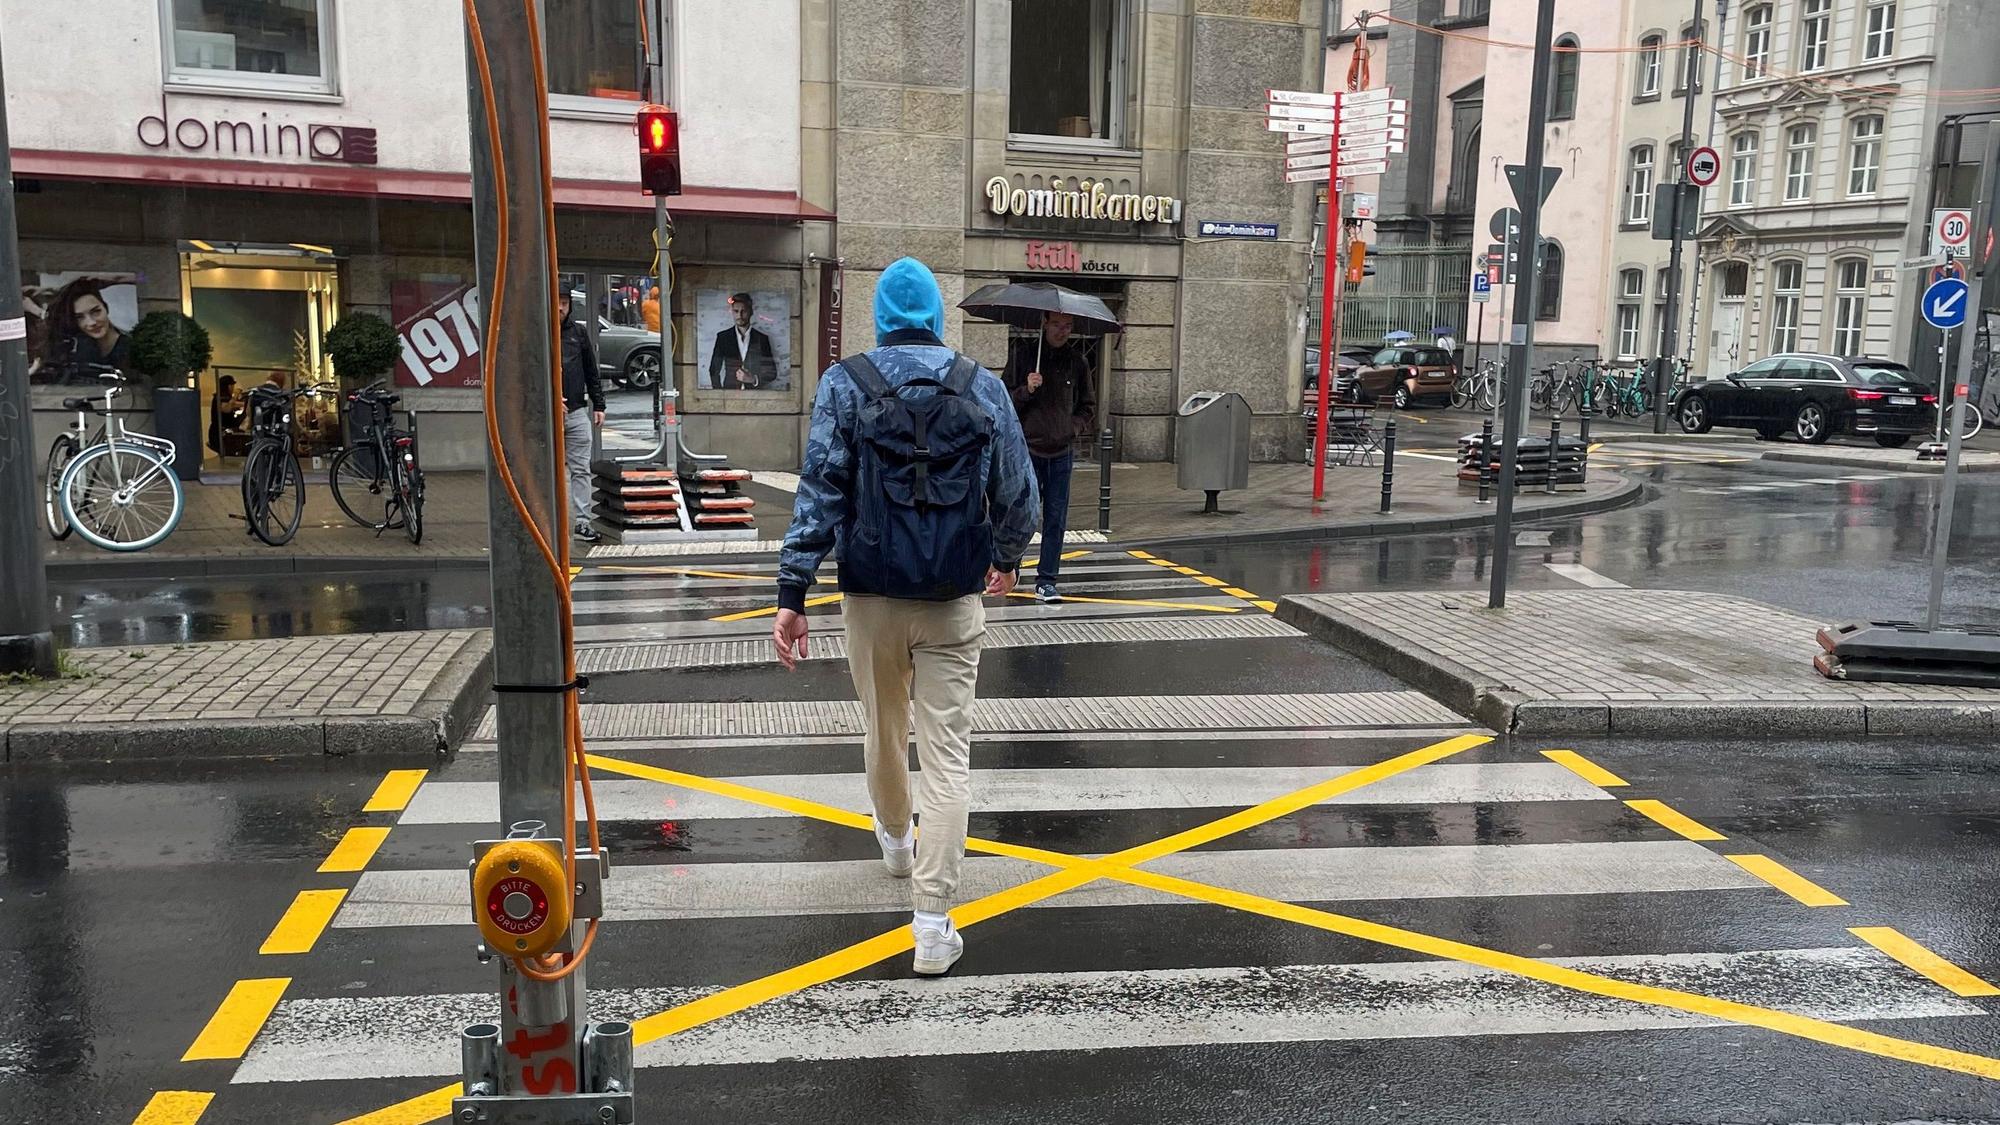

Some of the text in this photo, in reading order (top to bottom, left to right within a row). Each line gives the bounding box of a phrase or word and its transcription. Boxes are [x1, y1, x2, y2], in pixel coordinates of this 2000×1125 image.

[138, 94, 342, 159] domino
[986, 176, 1177, 224] Dominikaner
[1947, 220, 1963, 237] 30
[1025, 239, 1119, 273] Früh KÖLSCH
[500, 881, 531, 893] BITTE
